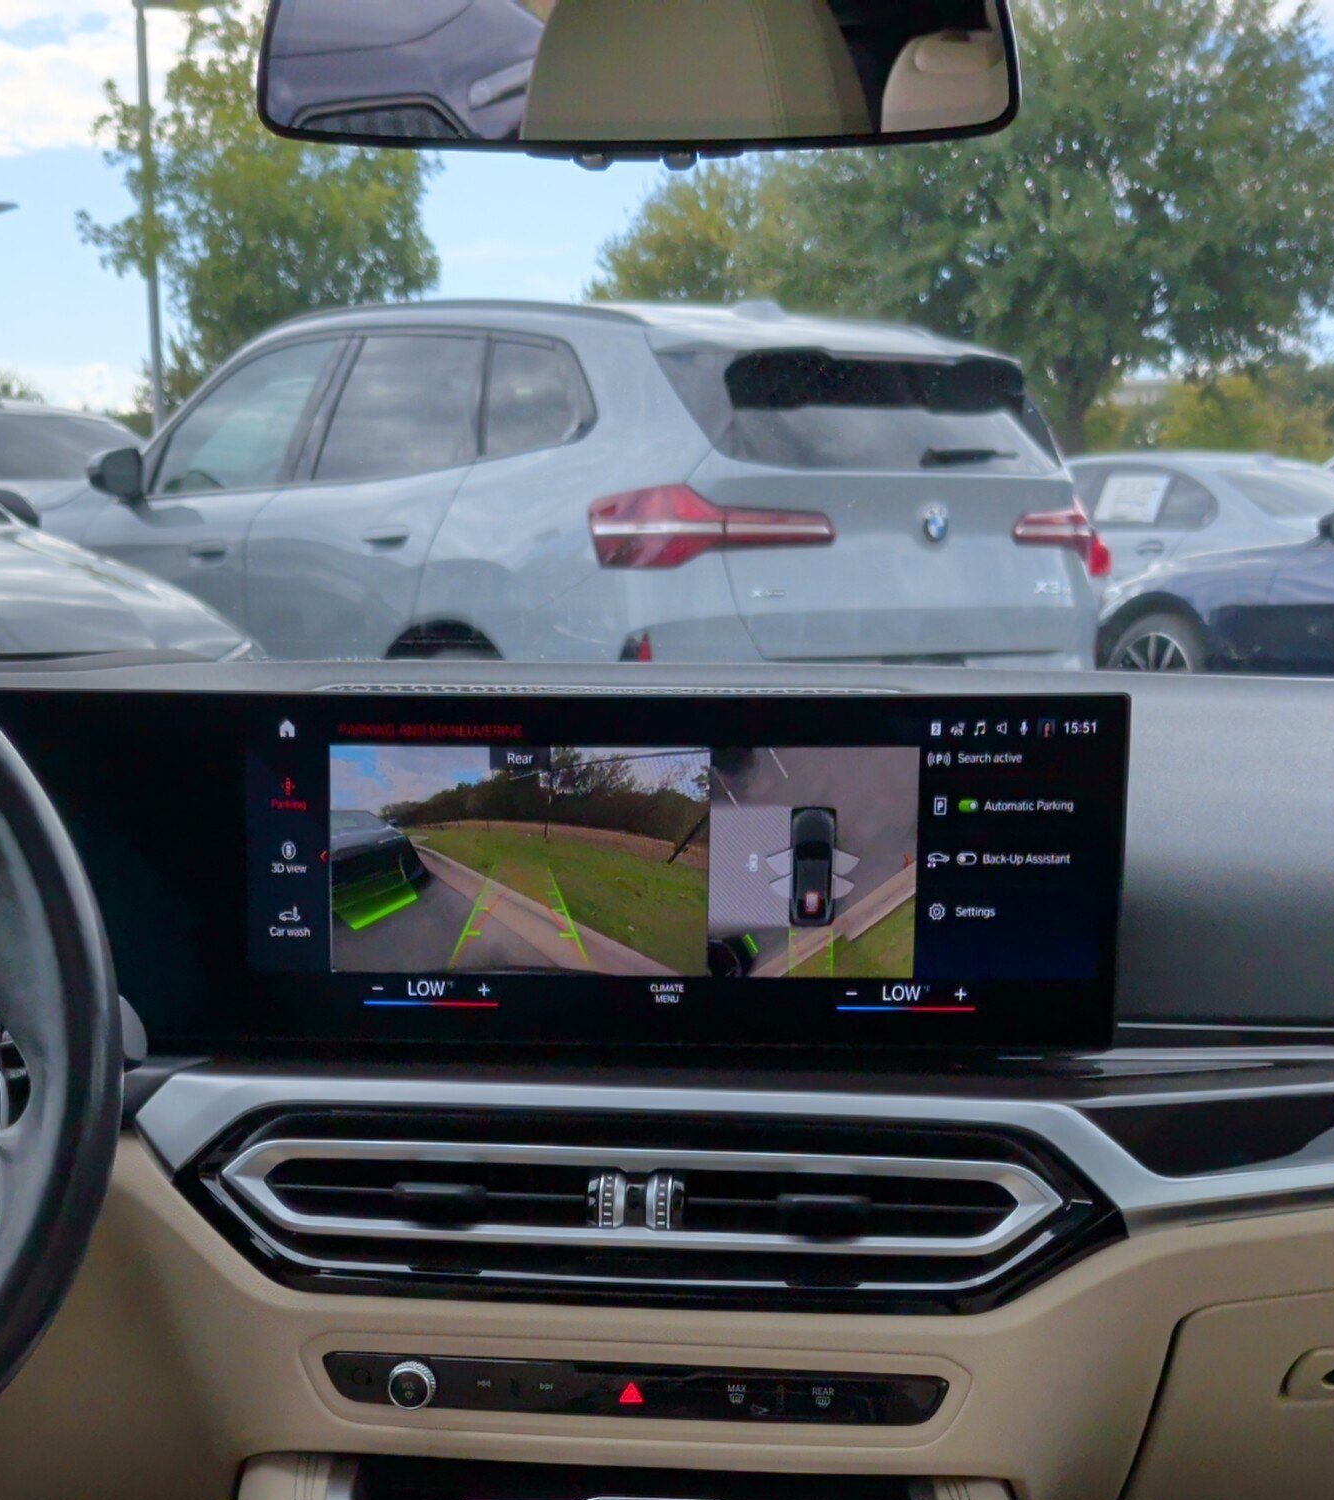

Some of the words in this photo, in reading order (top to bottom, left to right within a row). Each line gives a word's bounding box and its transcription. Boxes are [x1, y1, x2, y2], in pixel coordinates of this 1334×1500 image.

[338, 723, 395, 737] PARKING
[399, 723, 427, 738] AND
[1063, 720, 1098, 735] 15:51
[507, 752, 533, 765] Rear
[958, 751, 990, 764] Search
[993, 751, 1023, 764] active
[270, 799, 307, 812] Parking
[984, 799, 1035, 812] Automatic
[1037, 799, 1075, 813] Parking
[983, 852, 1023, 866] Back-Up
[1025, 851, 1071, 864] Assistant
[271, 863, 286, 874] 3D
[288, 863, 308, 874] view
[955, 905, 996, 919] Settings
[269, 927, 285, 938] Car
[287, 927, 311, 938] wash
[407, 980, 446, 997] LOW
[650, 983, 685, 993] CLIMATE
[882, 985, 921, 1001] LOW
[655, 994, 680, 1004] MENU
[727, 1384, 747, 1393] MAX
[812, 1386, 835, 1397] REAR
